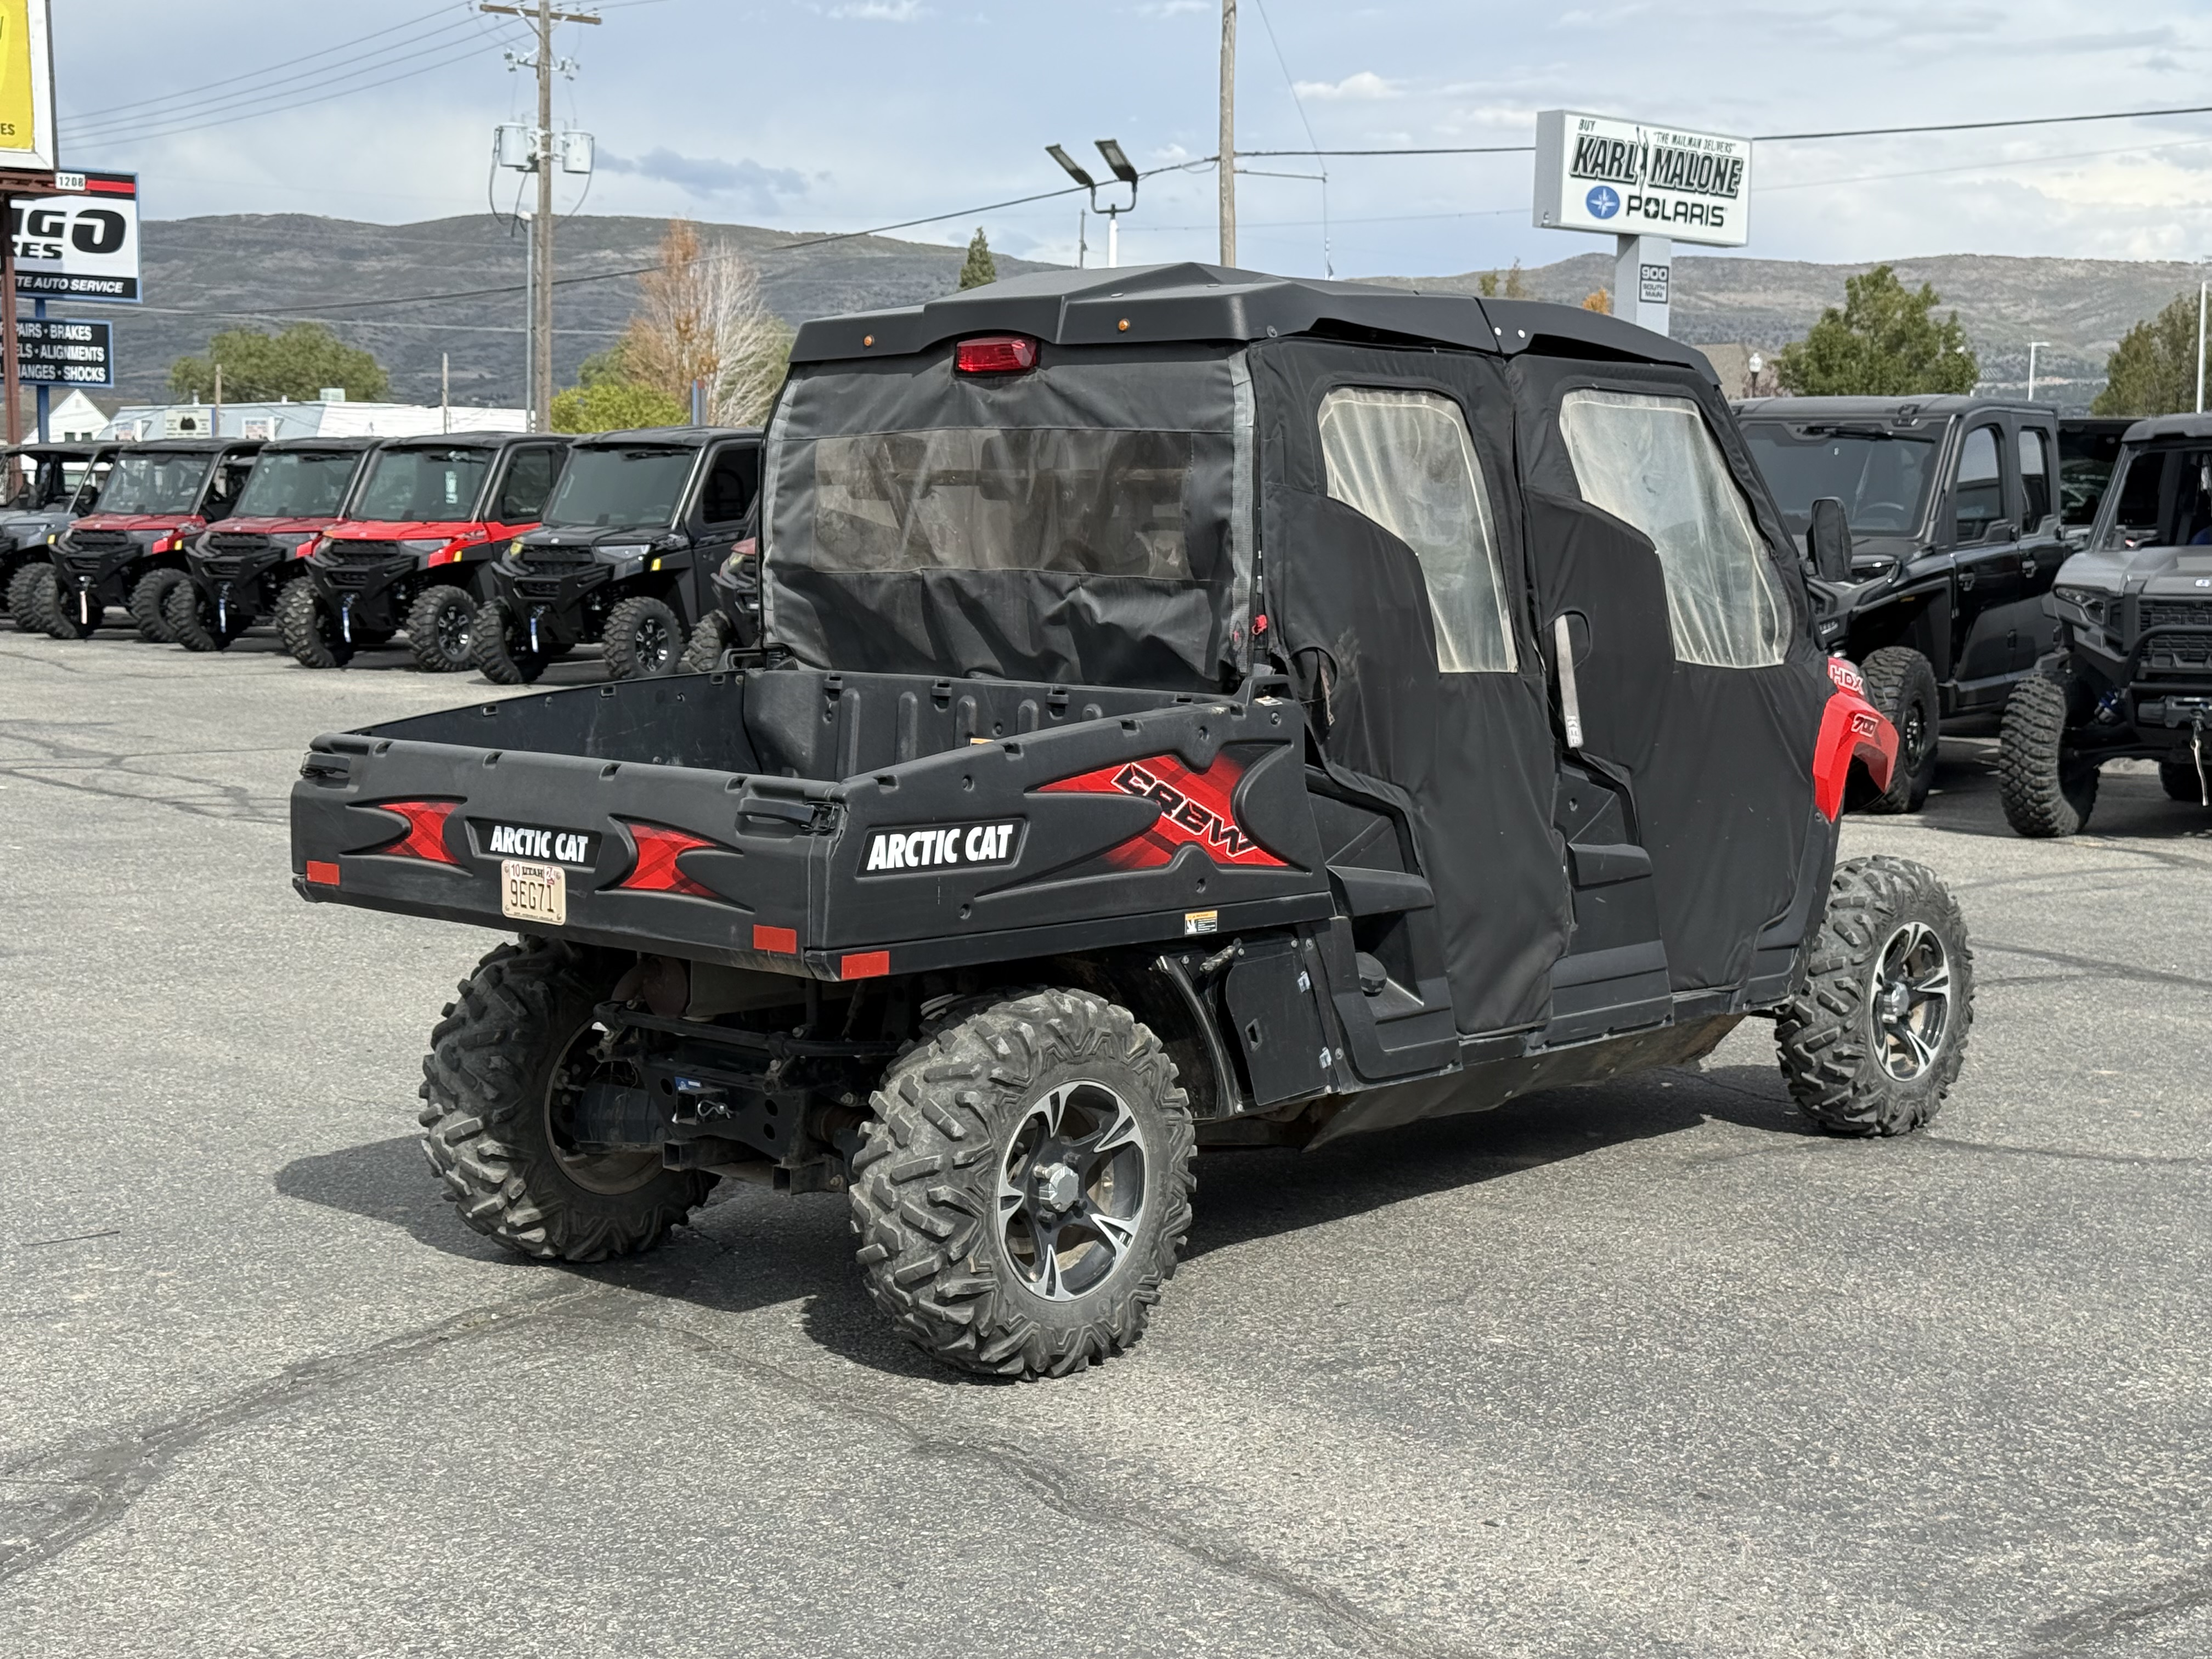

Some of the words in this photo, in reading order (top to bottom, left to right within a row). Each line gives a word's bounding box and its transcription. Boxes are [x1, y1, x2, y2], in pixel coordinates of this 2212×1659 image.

[1578, 119, 1595, 131] BUY
[1570, 133, 1639, 184] KARL
[1647, 145, 1744, 200] MALONE
[59, 177, 83, 187] 1208
[1626, 195, 1724, 227] POLARIS
[1641, 266, 1667, 280] 900
[33, 276, 69, 290] AUTO
[70, 279, 124, 294] SERVICE
[49, 324, 92, 341] BRAKES
[40, 344, 104, 362] ALIGNMENTS
[63, 365, 106, 382] SHOCKS
[1110, 762, 1258, 857] CREW
[490, 825, 552, 859] ARCTIC
[555, 833, 589, 863] CAT
[866, 828, 961, 871] ARCTIC
[965, 825, 1013, 861] CAT
[511, 864, 521, 877] 10
[522, 866, 544, 878] UTAH
[511, 879, 554, 913] 9EG71
